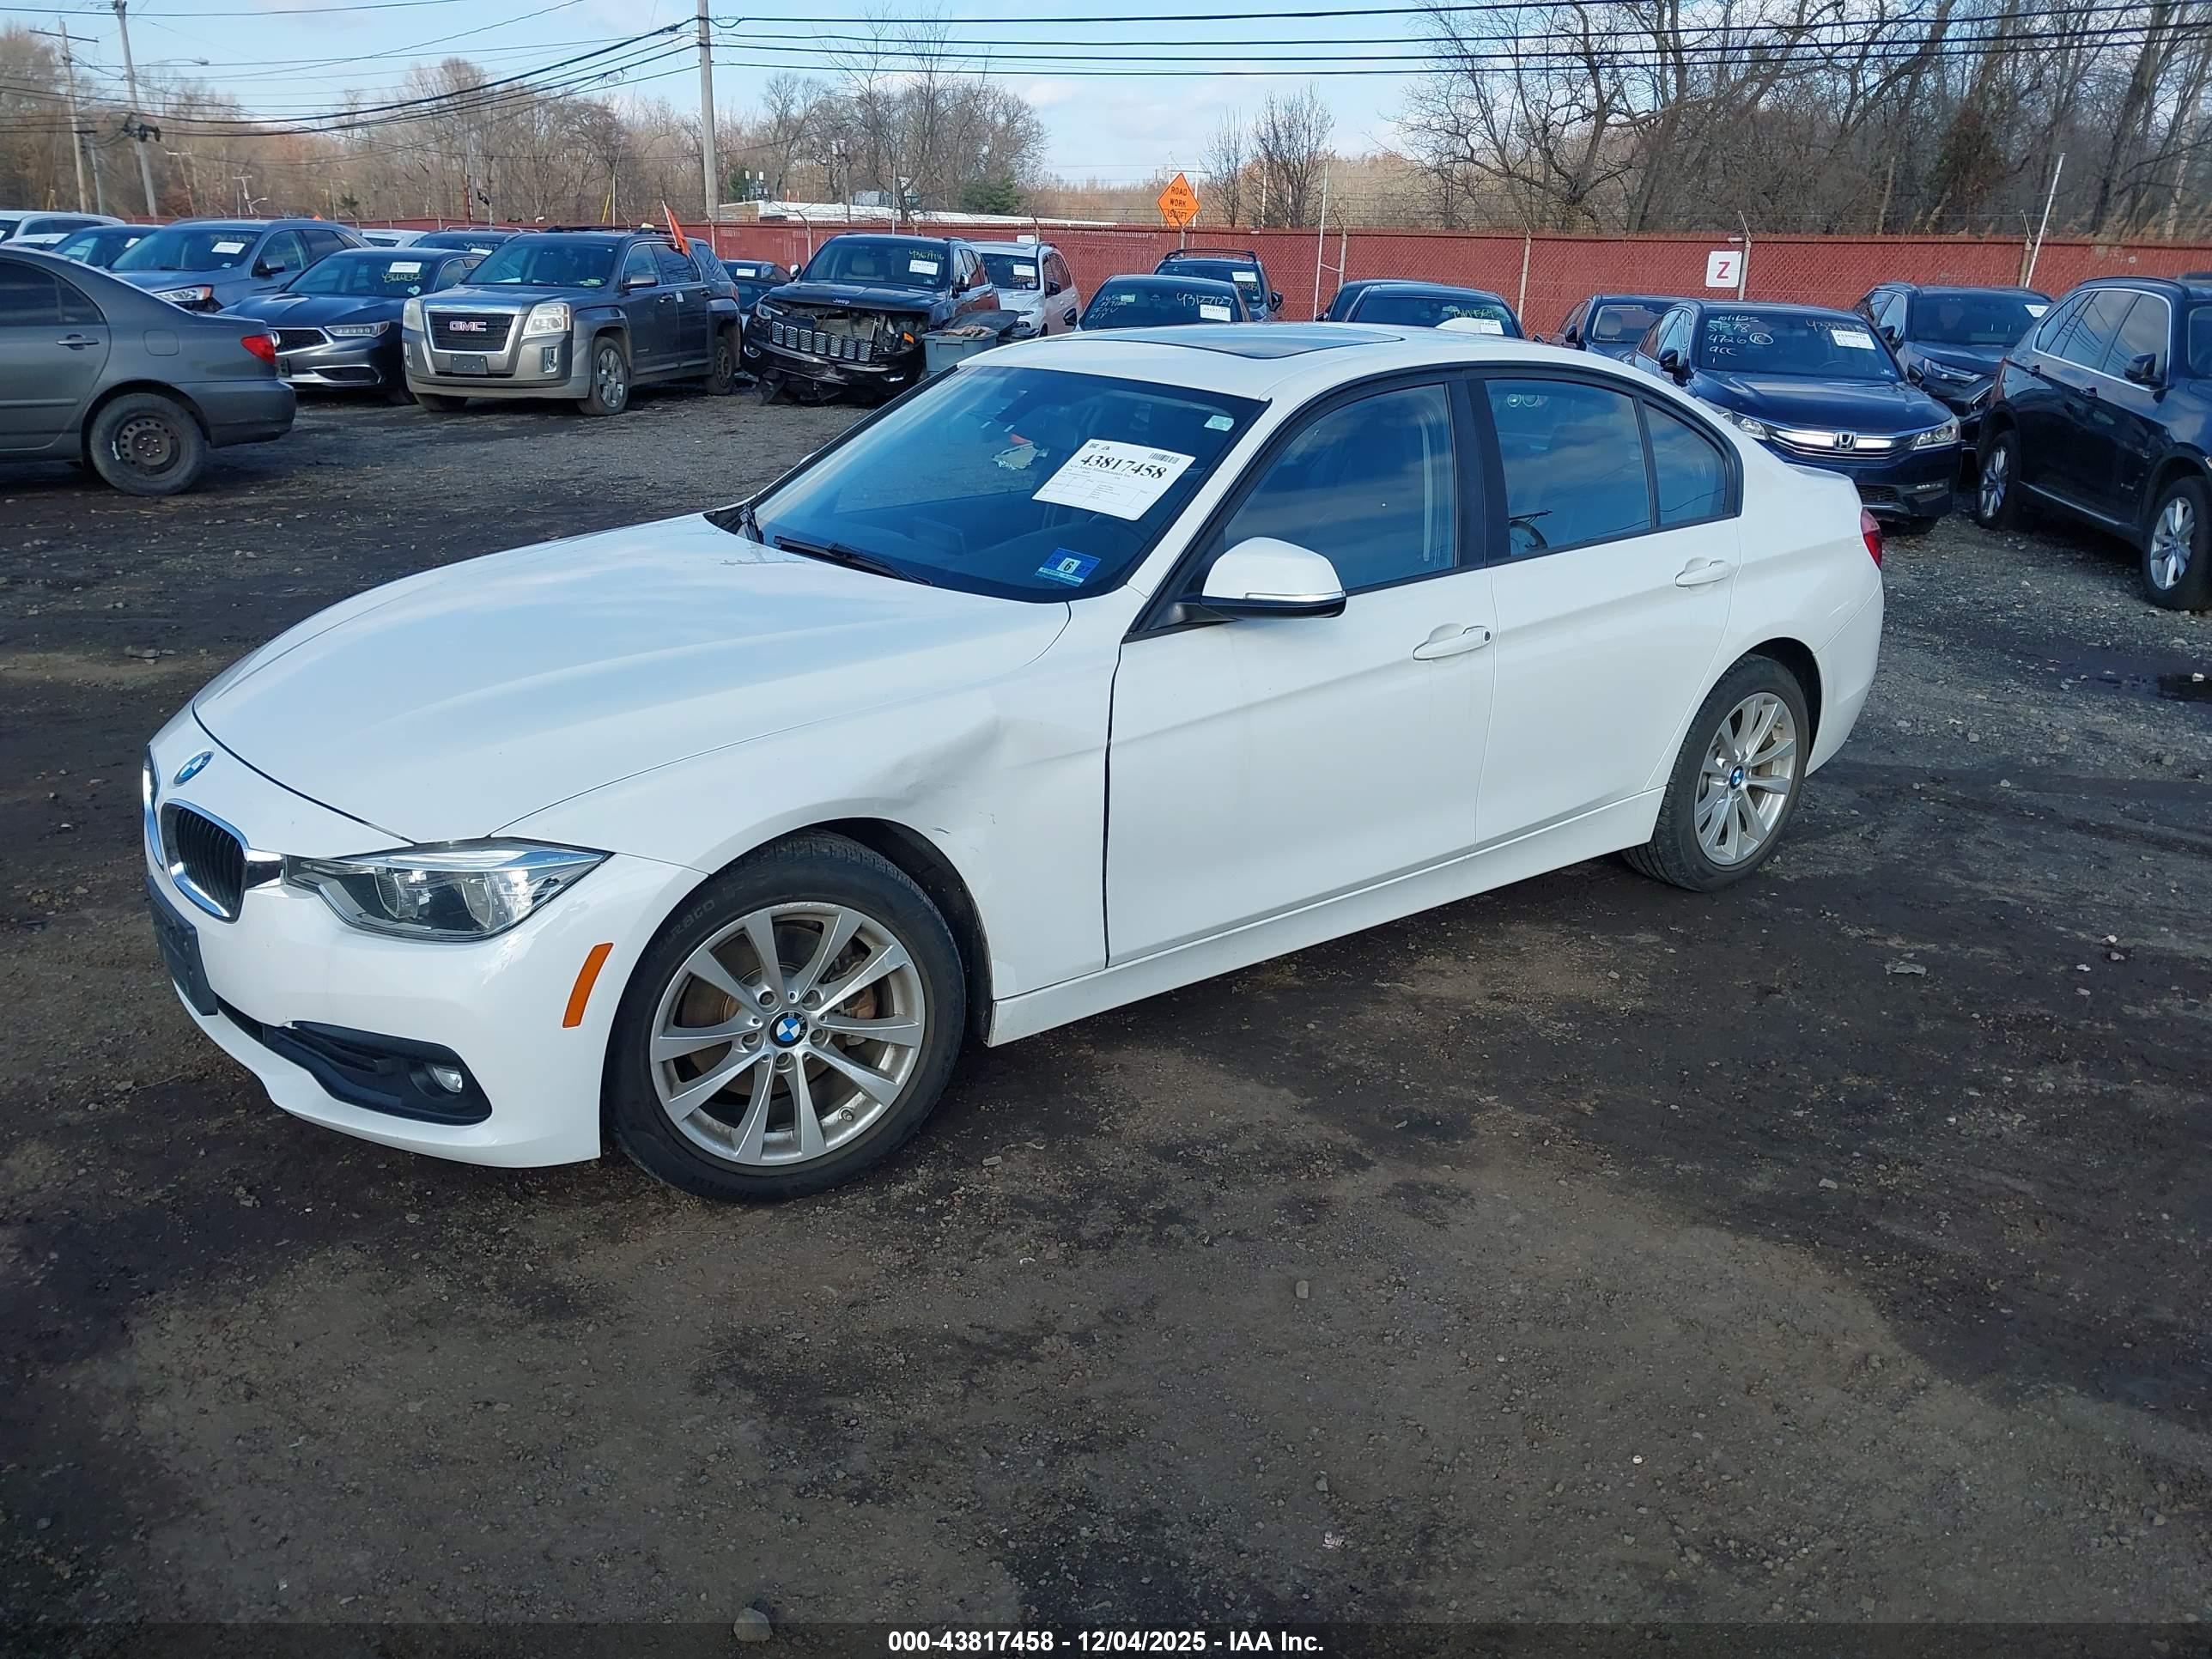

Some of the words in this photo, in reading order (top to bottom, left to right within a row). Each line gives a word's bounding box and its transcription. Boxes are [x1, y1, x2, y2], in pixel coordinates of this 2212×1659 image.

[1170, 186, 1188, 197] ROAD
[1170, 198, 1187, 208] WORK
[1717, 261, 1730, 279] Z
[449, 320, 488, 332] GMC
[1080, 454, 1167, 480] 43817458
[1064, 561, 1075, 571] 6
